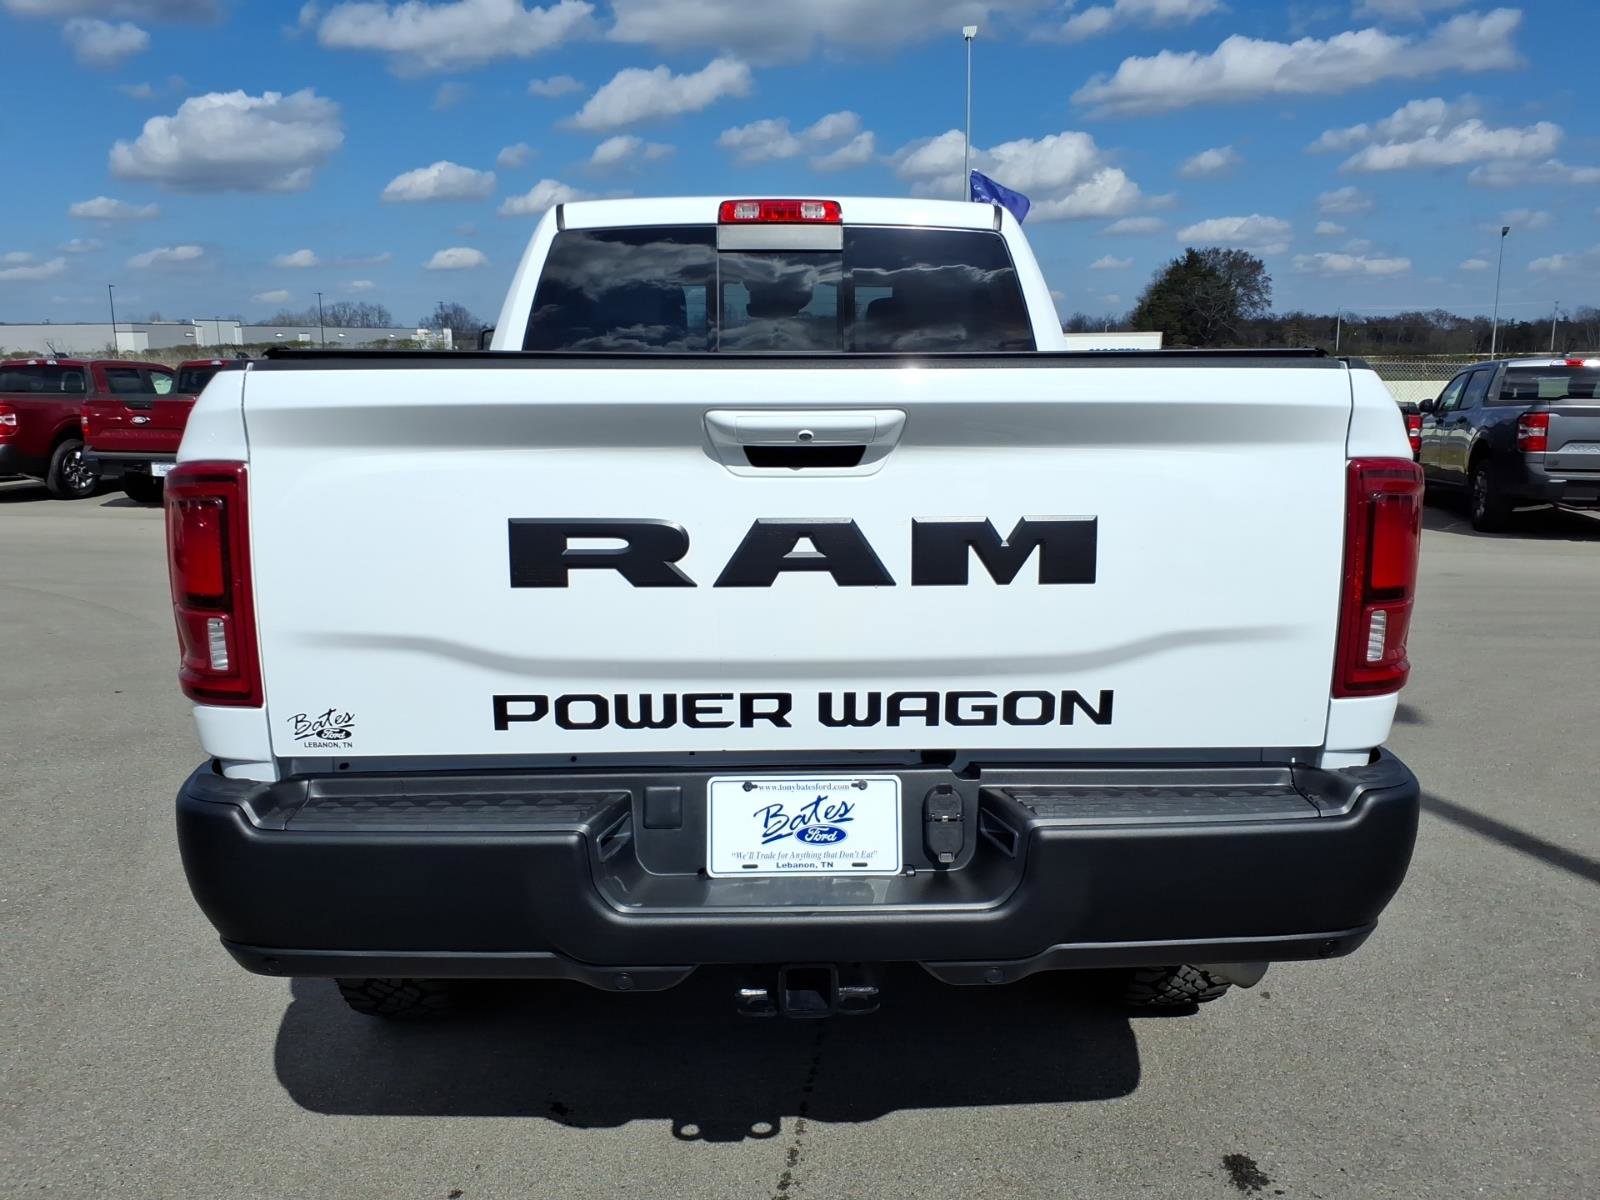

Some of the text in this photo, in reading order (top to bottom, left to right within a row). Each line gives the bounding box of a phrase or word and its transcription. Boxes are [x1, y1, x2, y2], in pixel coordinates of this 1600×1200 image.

[508, 515, 1098, 588] RAM
[492, 689, 1114, 731] POWER WAGON
[287, 708, 355, 736] Bates
[758, 783, 850, 792] www.tonybatesford.com
[754, 795, 855, 838] Bates
[804, 825, 838, 843] Ford
[755, 851, 776, 860] Trade
[777, 851, 788, 861] for
[790, 851, 821, 861] Anything
[823, 851, 837, 859] that
[776, 861, 818, 869] Lebanon,
